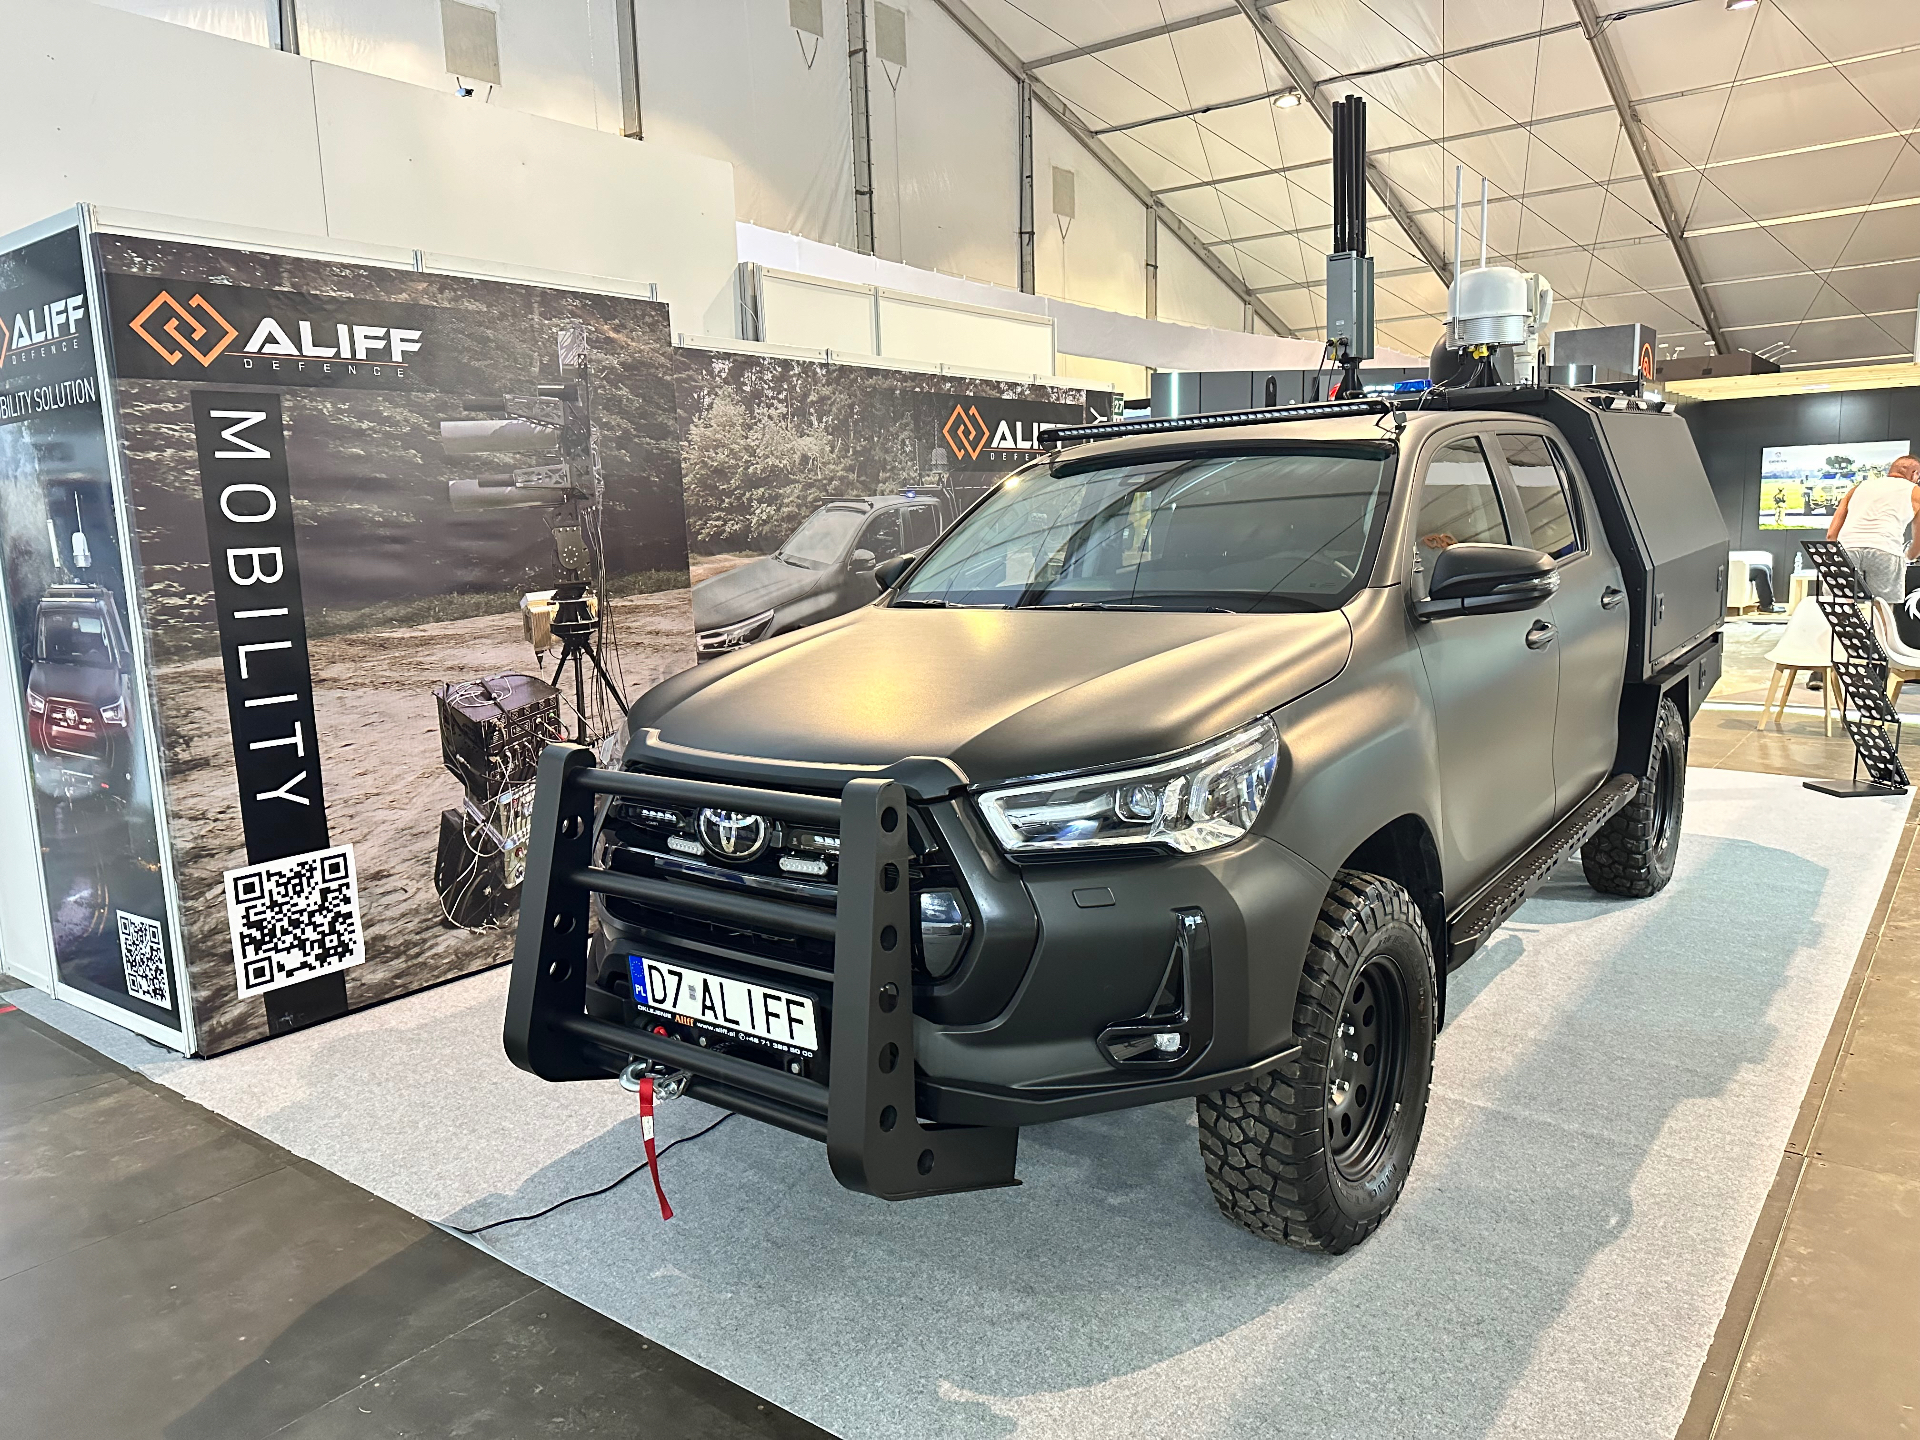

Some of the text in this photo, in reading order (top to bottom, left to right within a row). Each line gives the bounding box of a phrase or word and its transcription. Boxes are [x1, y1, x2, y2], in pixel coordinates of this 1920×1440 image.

[11, 294, 85, 349] ALIFF
[243, 317, 423, 362] ALIFF
[11, 339, 79, 364] DEFENCE
[243, 358, 404, 377] DEFENCE
[0, 376, 96, 419] BILITY SOLUTION
[1114, 400, 1123, 413] 27
[209, 409, 310, 806] MOBILITY
[635, 983, 647, 997] PL
[648, 964, 805, 1040] D7 ALIFF
